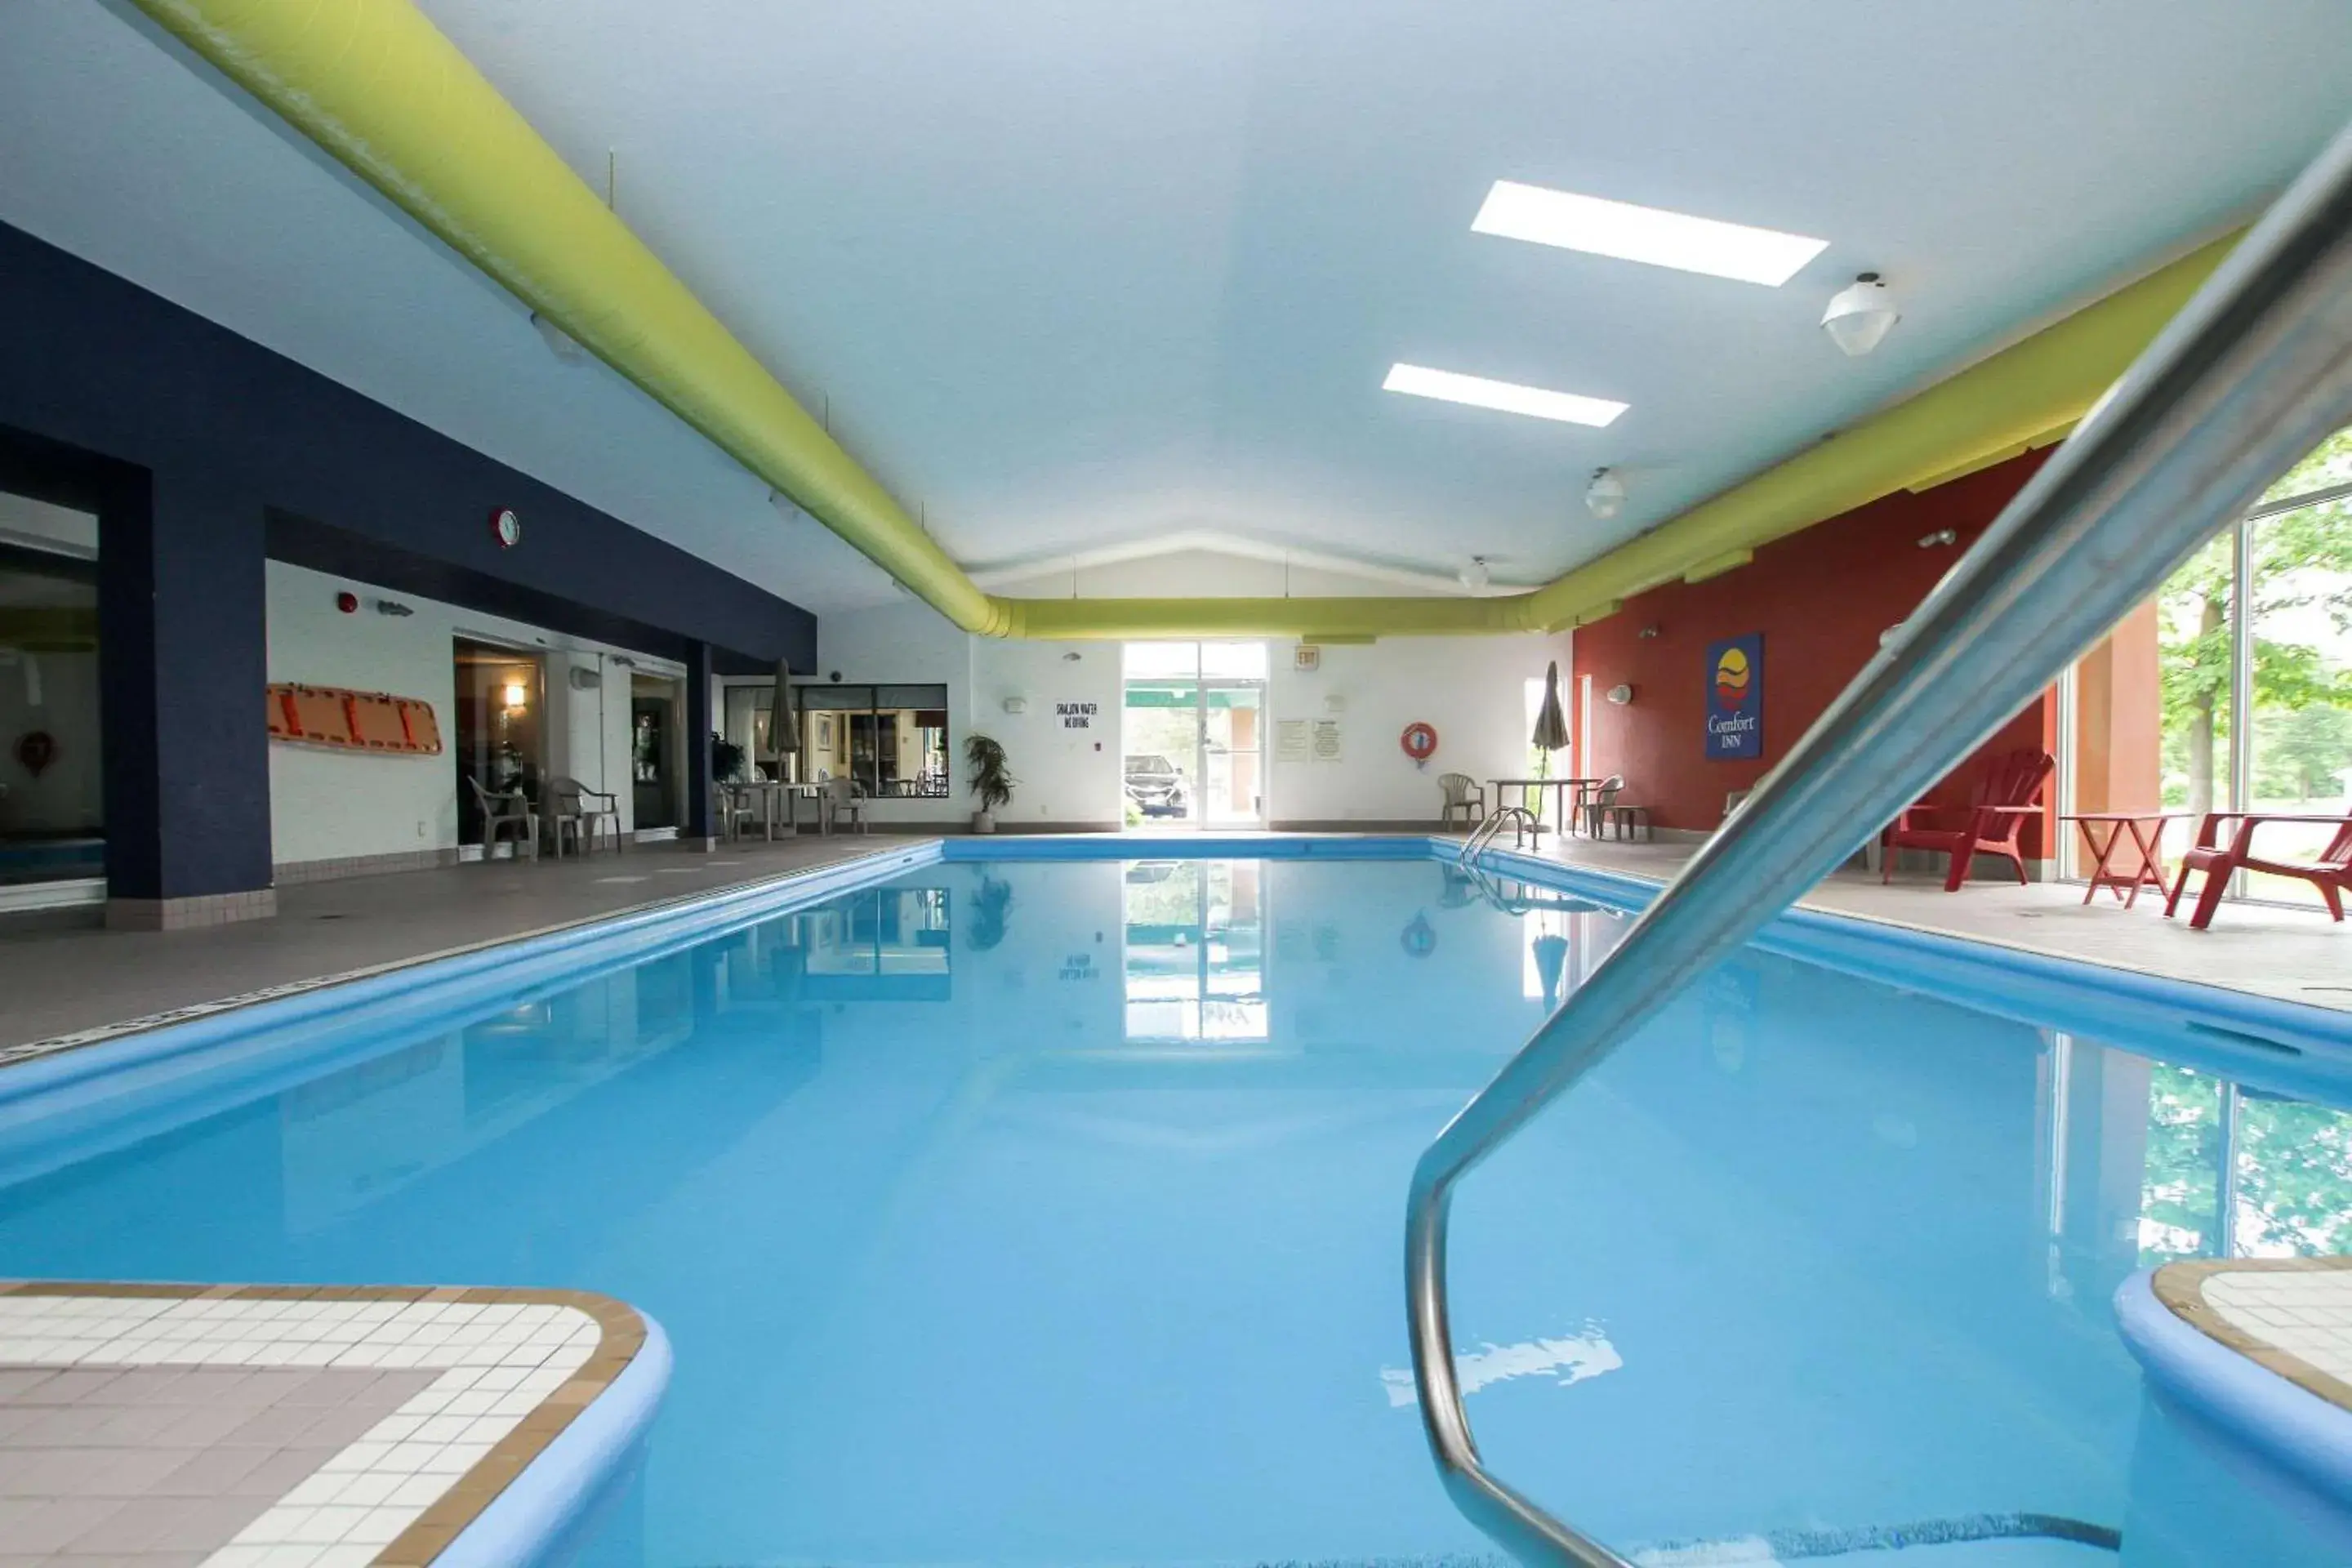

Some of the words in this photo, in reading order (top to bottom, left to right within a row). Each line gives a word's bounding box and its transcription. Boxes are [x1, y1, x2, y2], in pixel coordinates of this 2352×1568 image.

[1080, 703, 1097, 715] WATER
[1064, 716, 1071, 728] NO
[1072, 716, 1089, 728] DIVING
[1708, 710, 1755, 733] Comfort
[1721, 734, 1741, 748] INN
